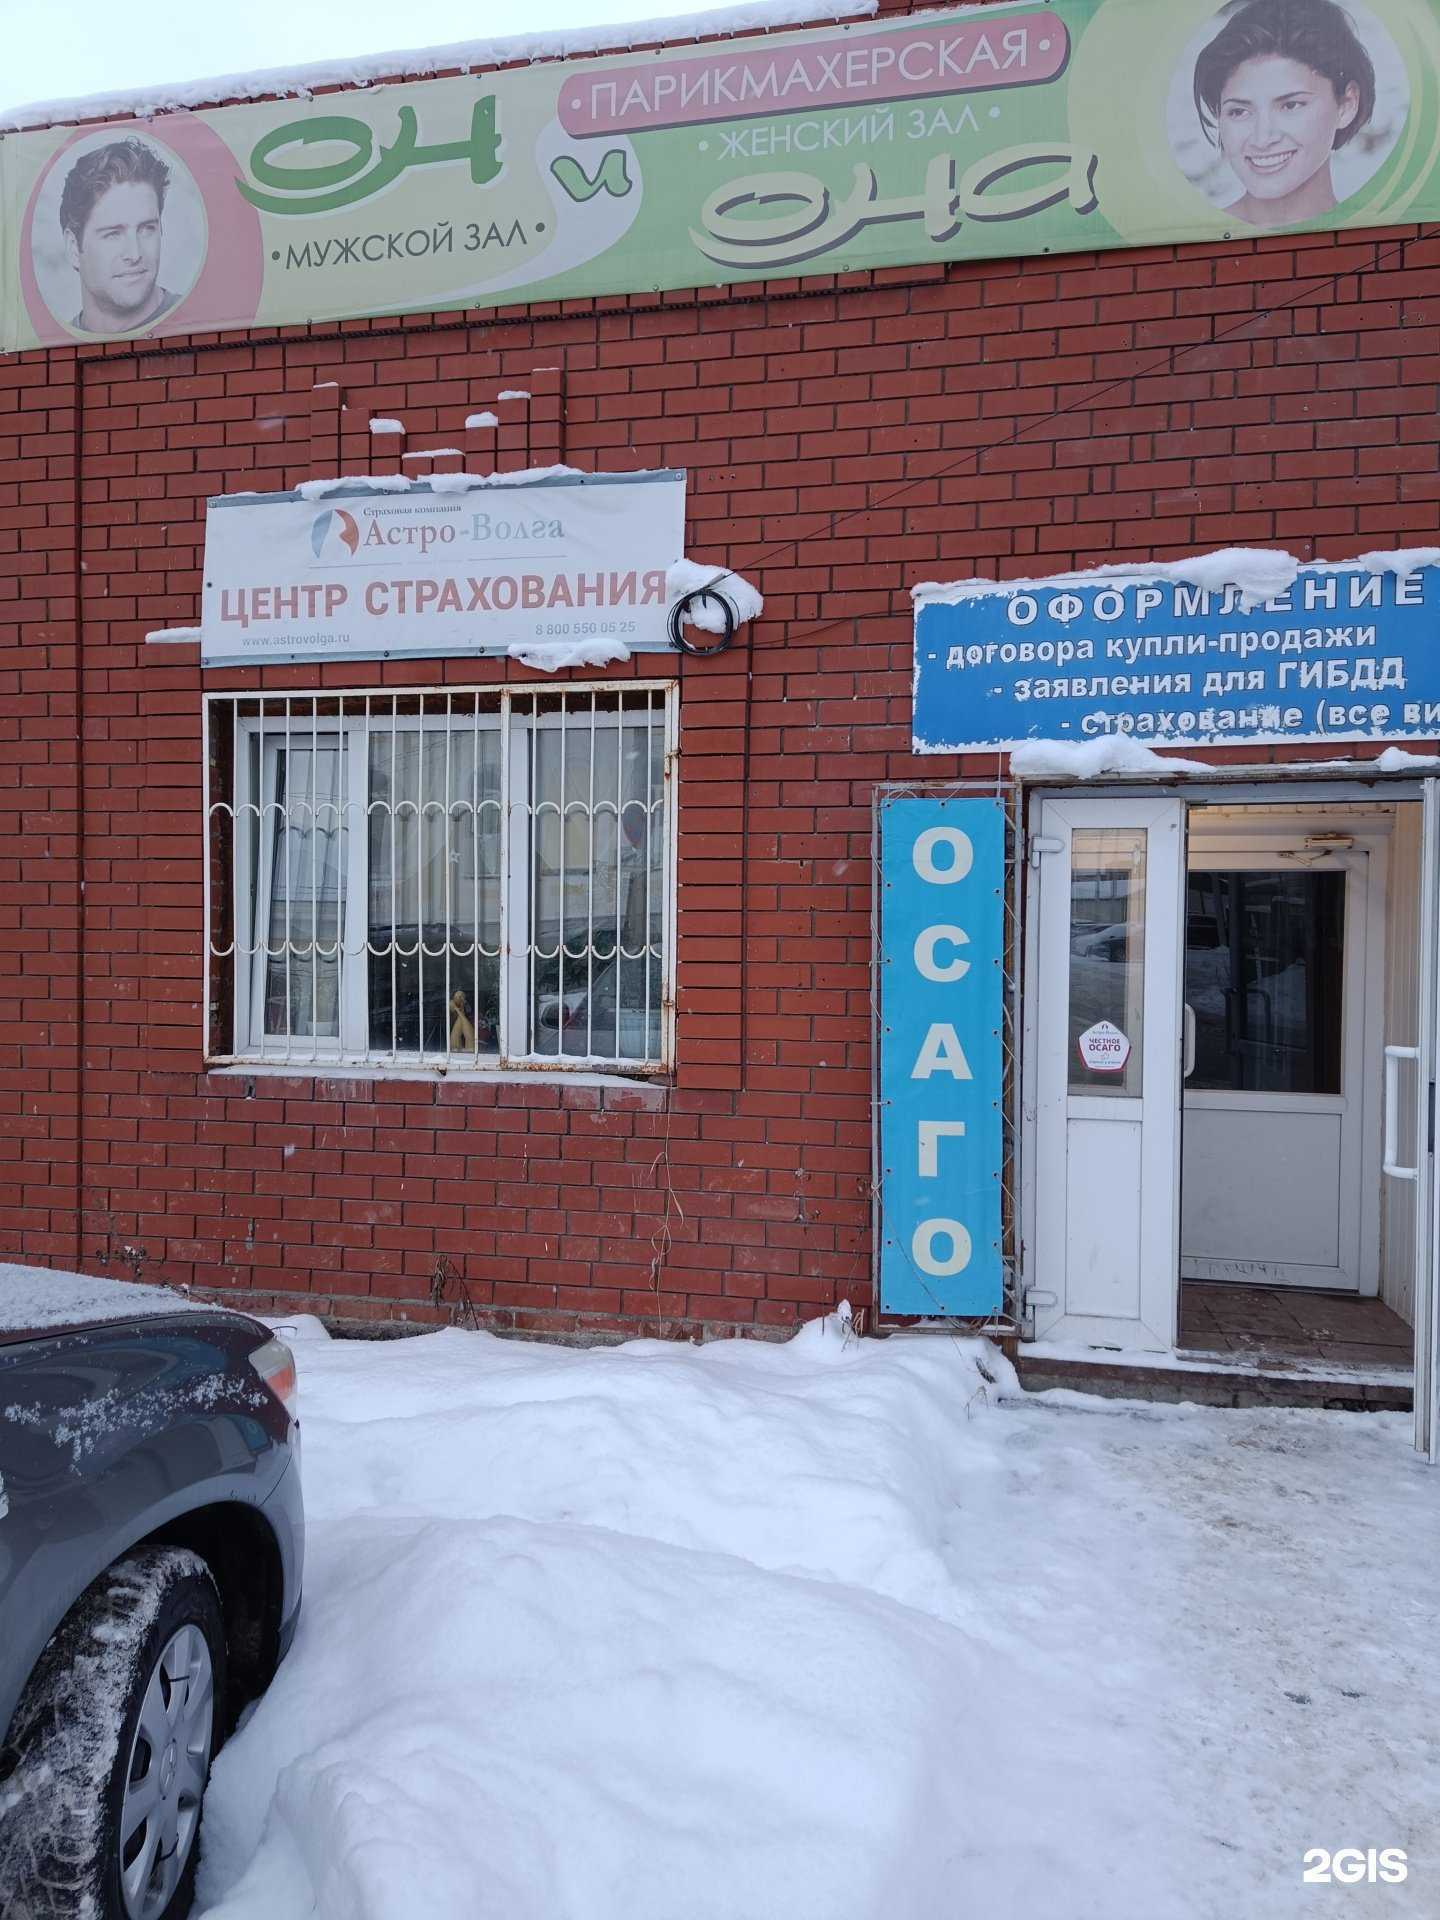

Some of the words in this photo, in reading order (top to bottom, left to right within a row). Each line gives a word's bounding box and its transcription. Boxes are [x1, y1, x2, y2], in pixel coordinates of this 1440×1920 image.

[590, 29, 1029, 120] ПАРИКМАХЕРСКАЯ
[717, 109, 895, 160] ЖЕНСКИЙ
[906, 105, 979, 139] ЗАЛ
[285, 222, 454, 270] МУЖСКОЙ
[464, 219, 528, 250] ЗАЛ
[220, 583, 349, 628] ЦЕНТР
[365, 569, 668, 616] СТРАХОВАНИЯ
[242, 632, 350, 647] www.astrovolga.ru
[535, 624, 543, 635] 8
[546, 623, 570, 635] 800
[620, 620, 636, 633] 25
[945, 638, 1094, 670] договора
[1106, 625, 1377, 664] купли-продажи
[1014, 673, 1191, 701] заявления
[1203, 670, 1265, 694] для
[1278, 656, 1405, 691] ГИБДД
[1081, 706, 1304, 734] страхование
[910, 826, 974, 1276] ОСАГО
[1089, 1044, 1121, 1052] ОСАГО
